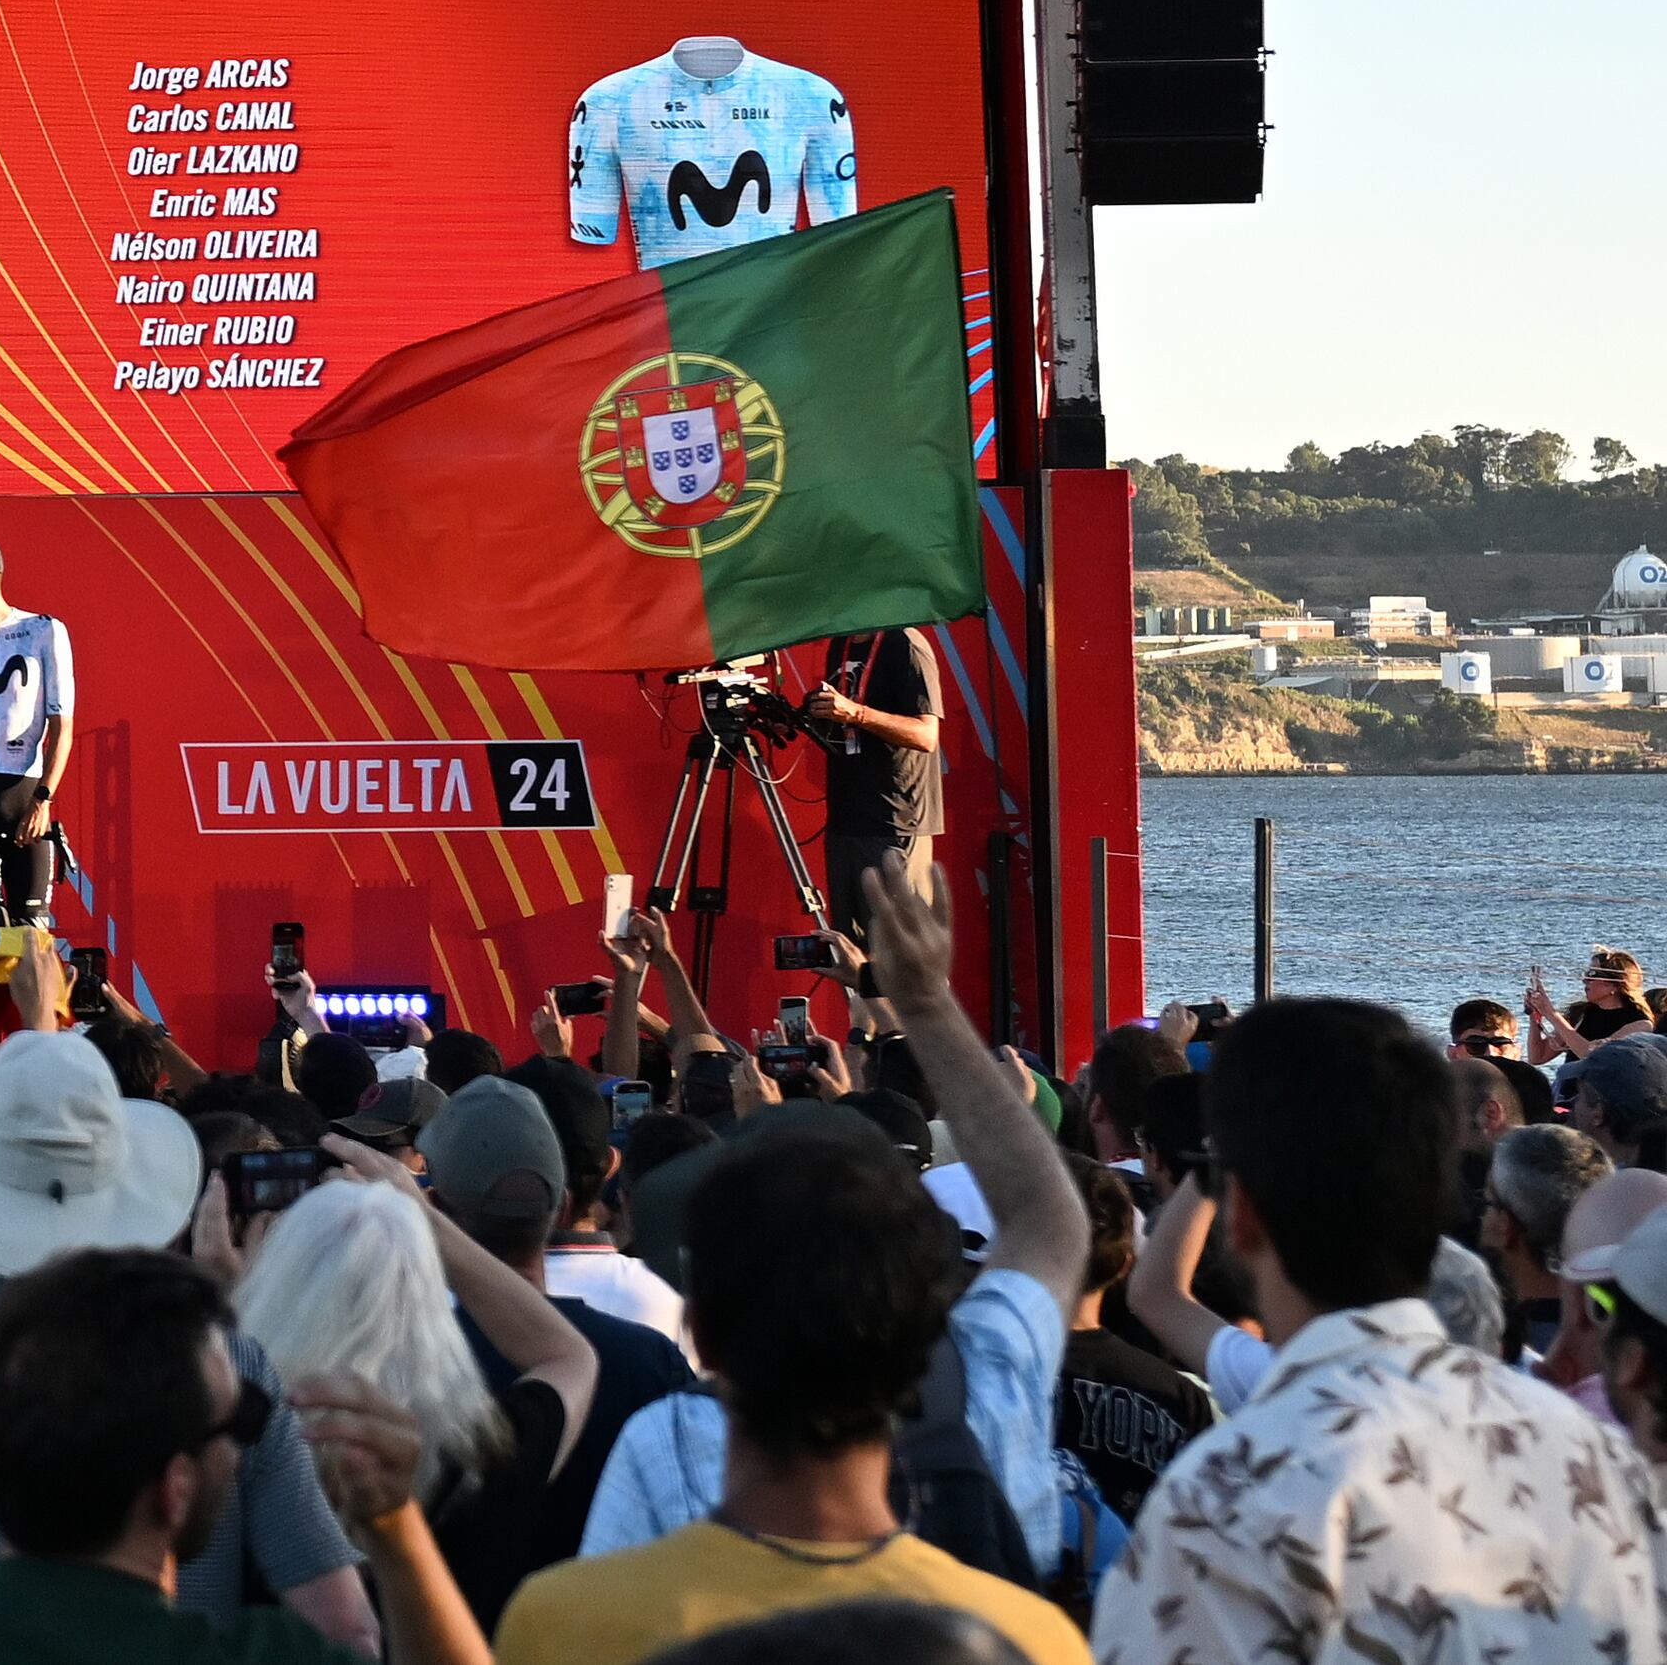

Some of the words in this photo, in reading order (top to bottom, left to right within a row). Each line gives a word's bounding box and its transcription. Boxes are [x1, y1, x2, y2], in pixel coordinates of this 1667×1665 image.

[128, 61, 200, 95] Jorge
[203, 58, 290, 89] ARCAS
[126, 103, 209, 133] Carlos
[215, 101, 295, 131] CANAL
[731, 107, 771, 120] GOBIK
[127, 146, 182, 176] Oier
[185, 143, 299, 175] LAZKANO
[149, 188, 217, 218] Enric
[221, 186, 278, 216] MAS
[110, 231, 197, 262] Nélson
[203, 228, 317, 260] OLIVEIRA
[115, 274, 185, 304] Nairo
[191, 271, 314, 304] QUINTANA
[139, 317, 208, 347] Einer
[212, 315, 295, 345] RUBIO
[113, 360, 200, 395] Pelayo
[205, 353, 324, 390] SÁNCHEZ
[217, 760, 276, 815] LA
[284, 758, 473, 815] VUELTA
[508, 758, 571, 812] 24
